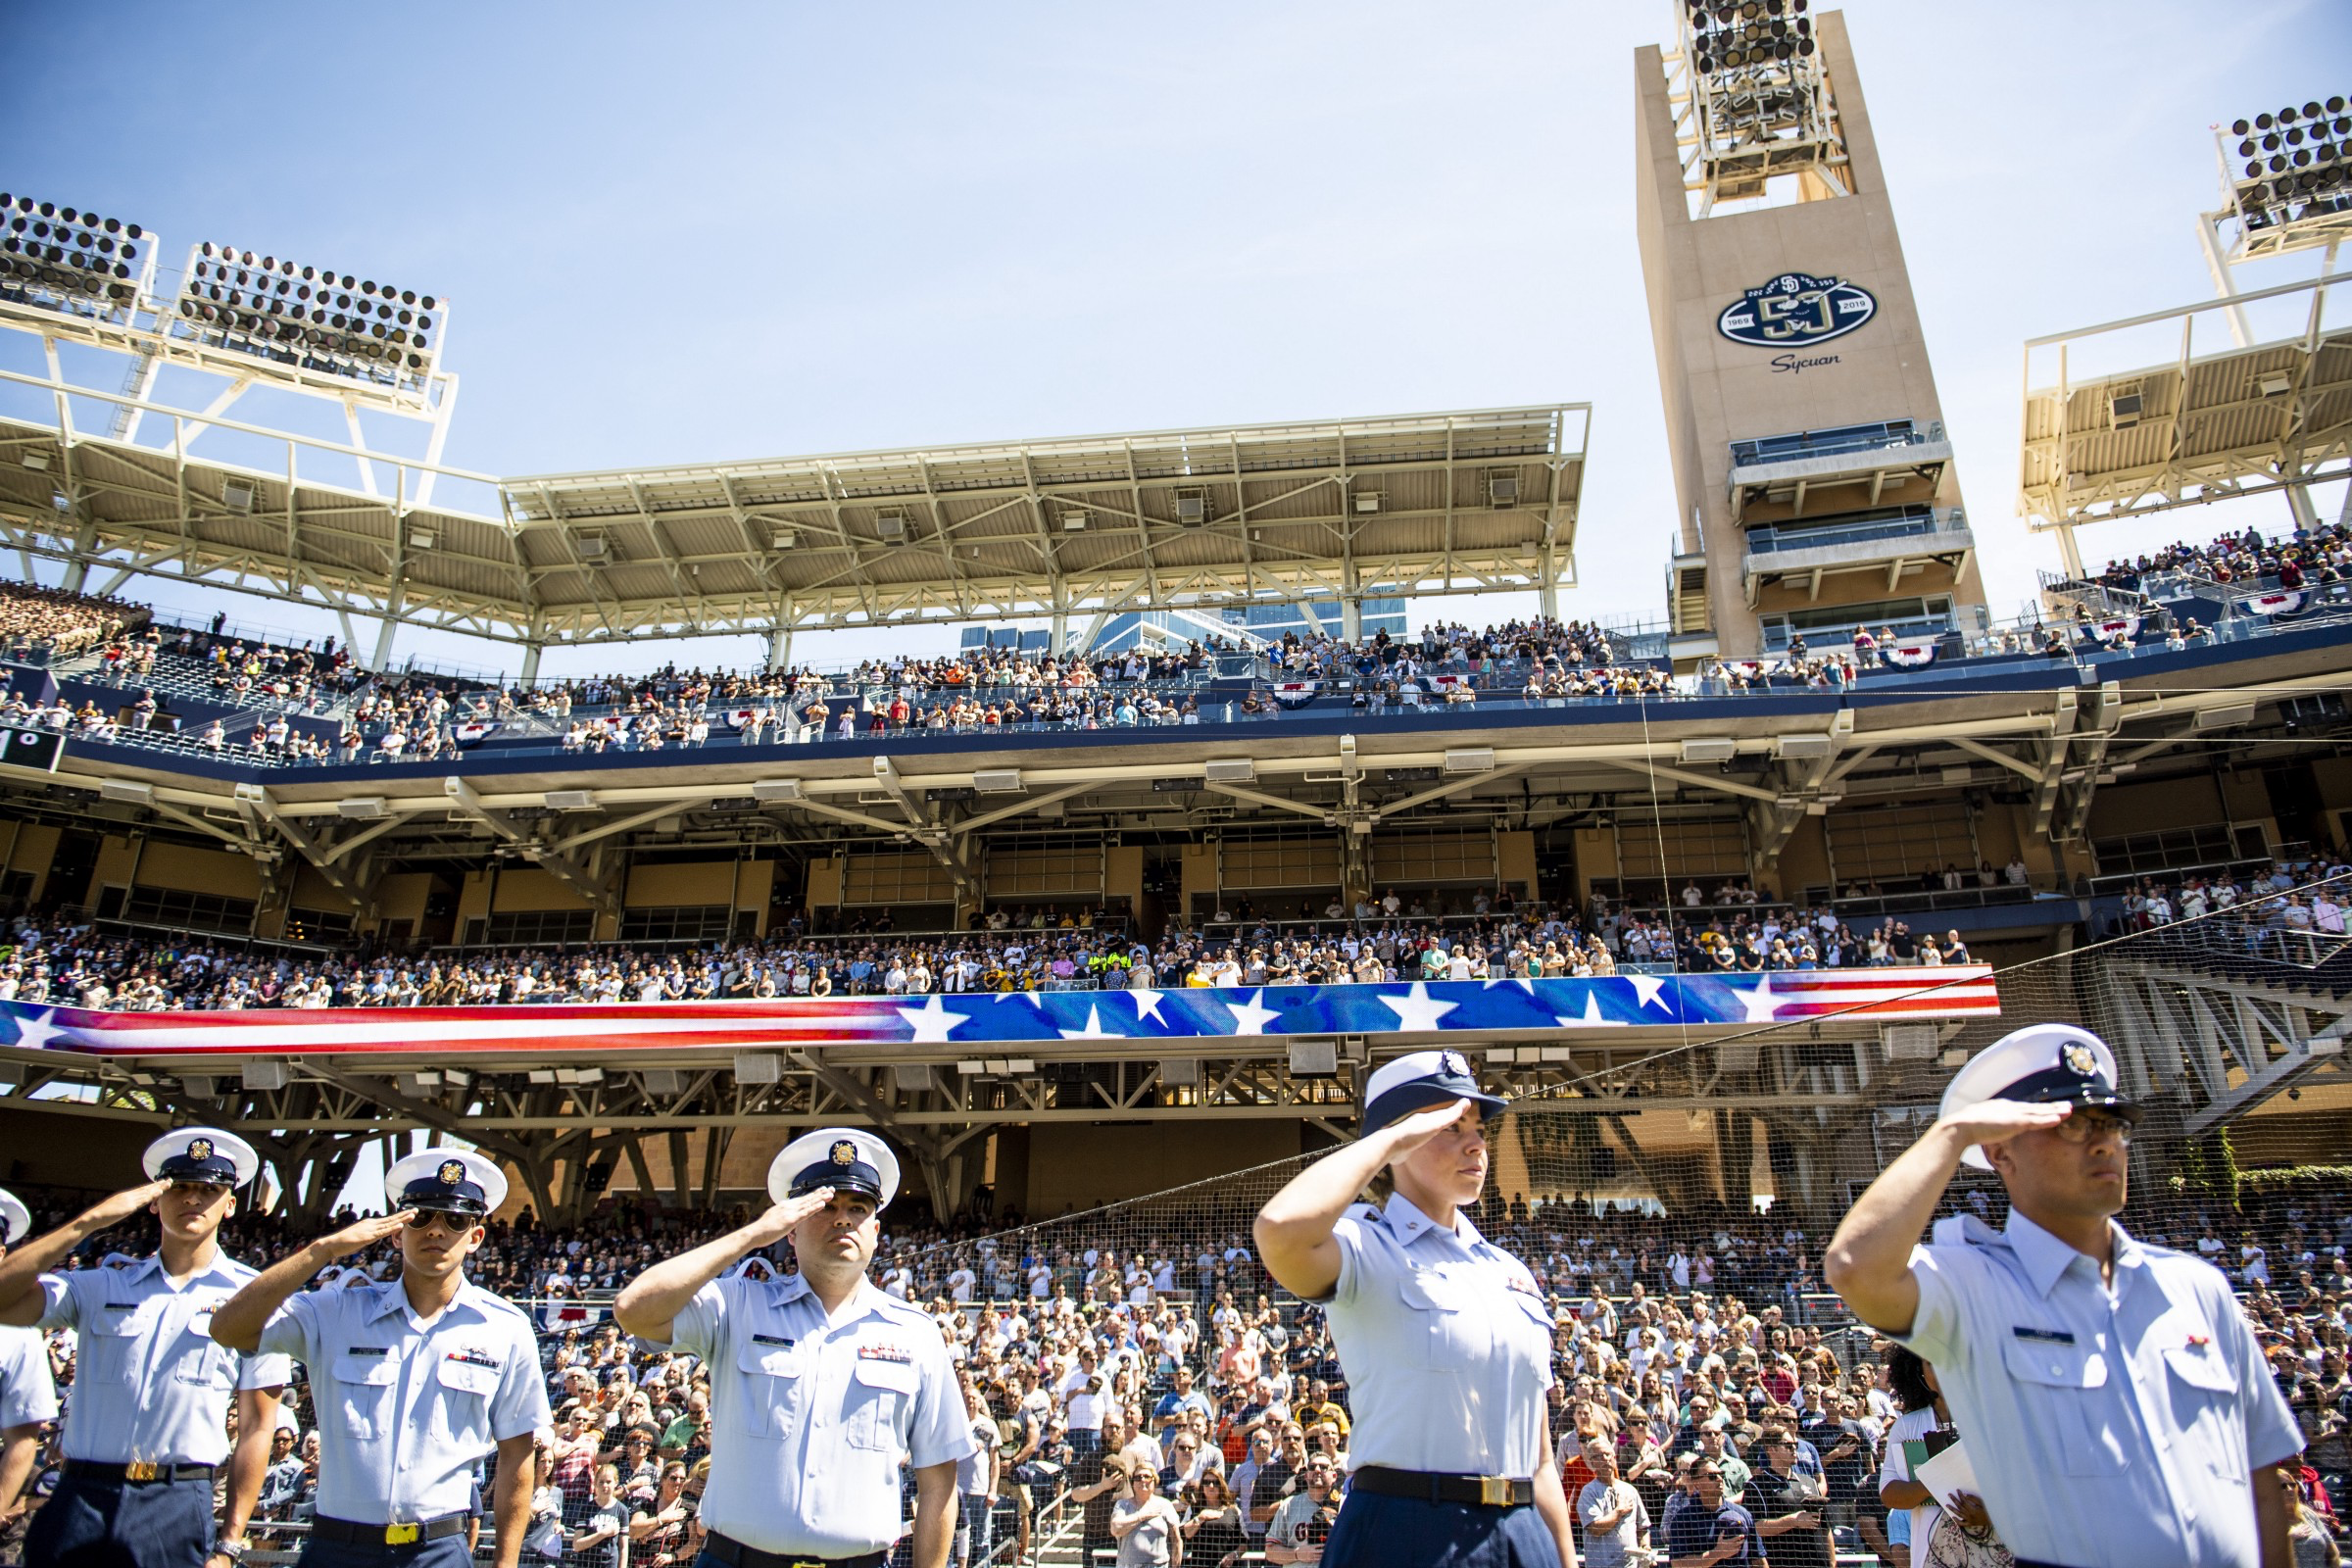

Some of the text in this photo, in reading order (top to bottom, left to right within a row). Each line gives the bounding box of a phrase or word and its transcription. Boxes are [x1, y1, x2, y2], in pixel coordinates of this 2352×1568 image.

[1843, 301, 1866, 310] 2019
[1728, 318, 1749, 326] 1969
[1771, 354, 1841, 374] Sycuan
